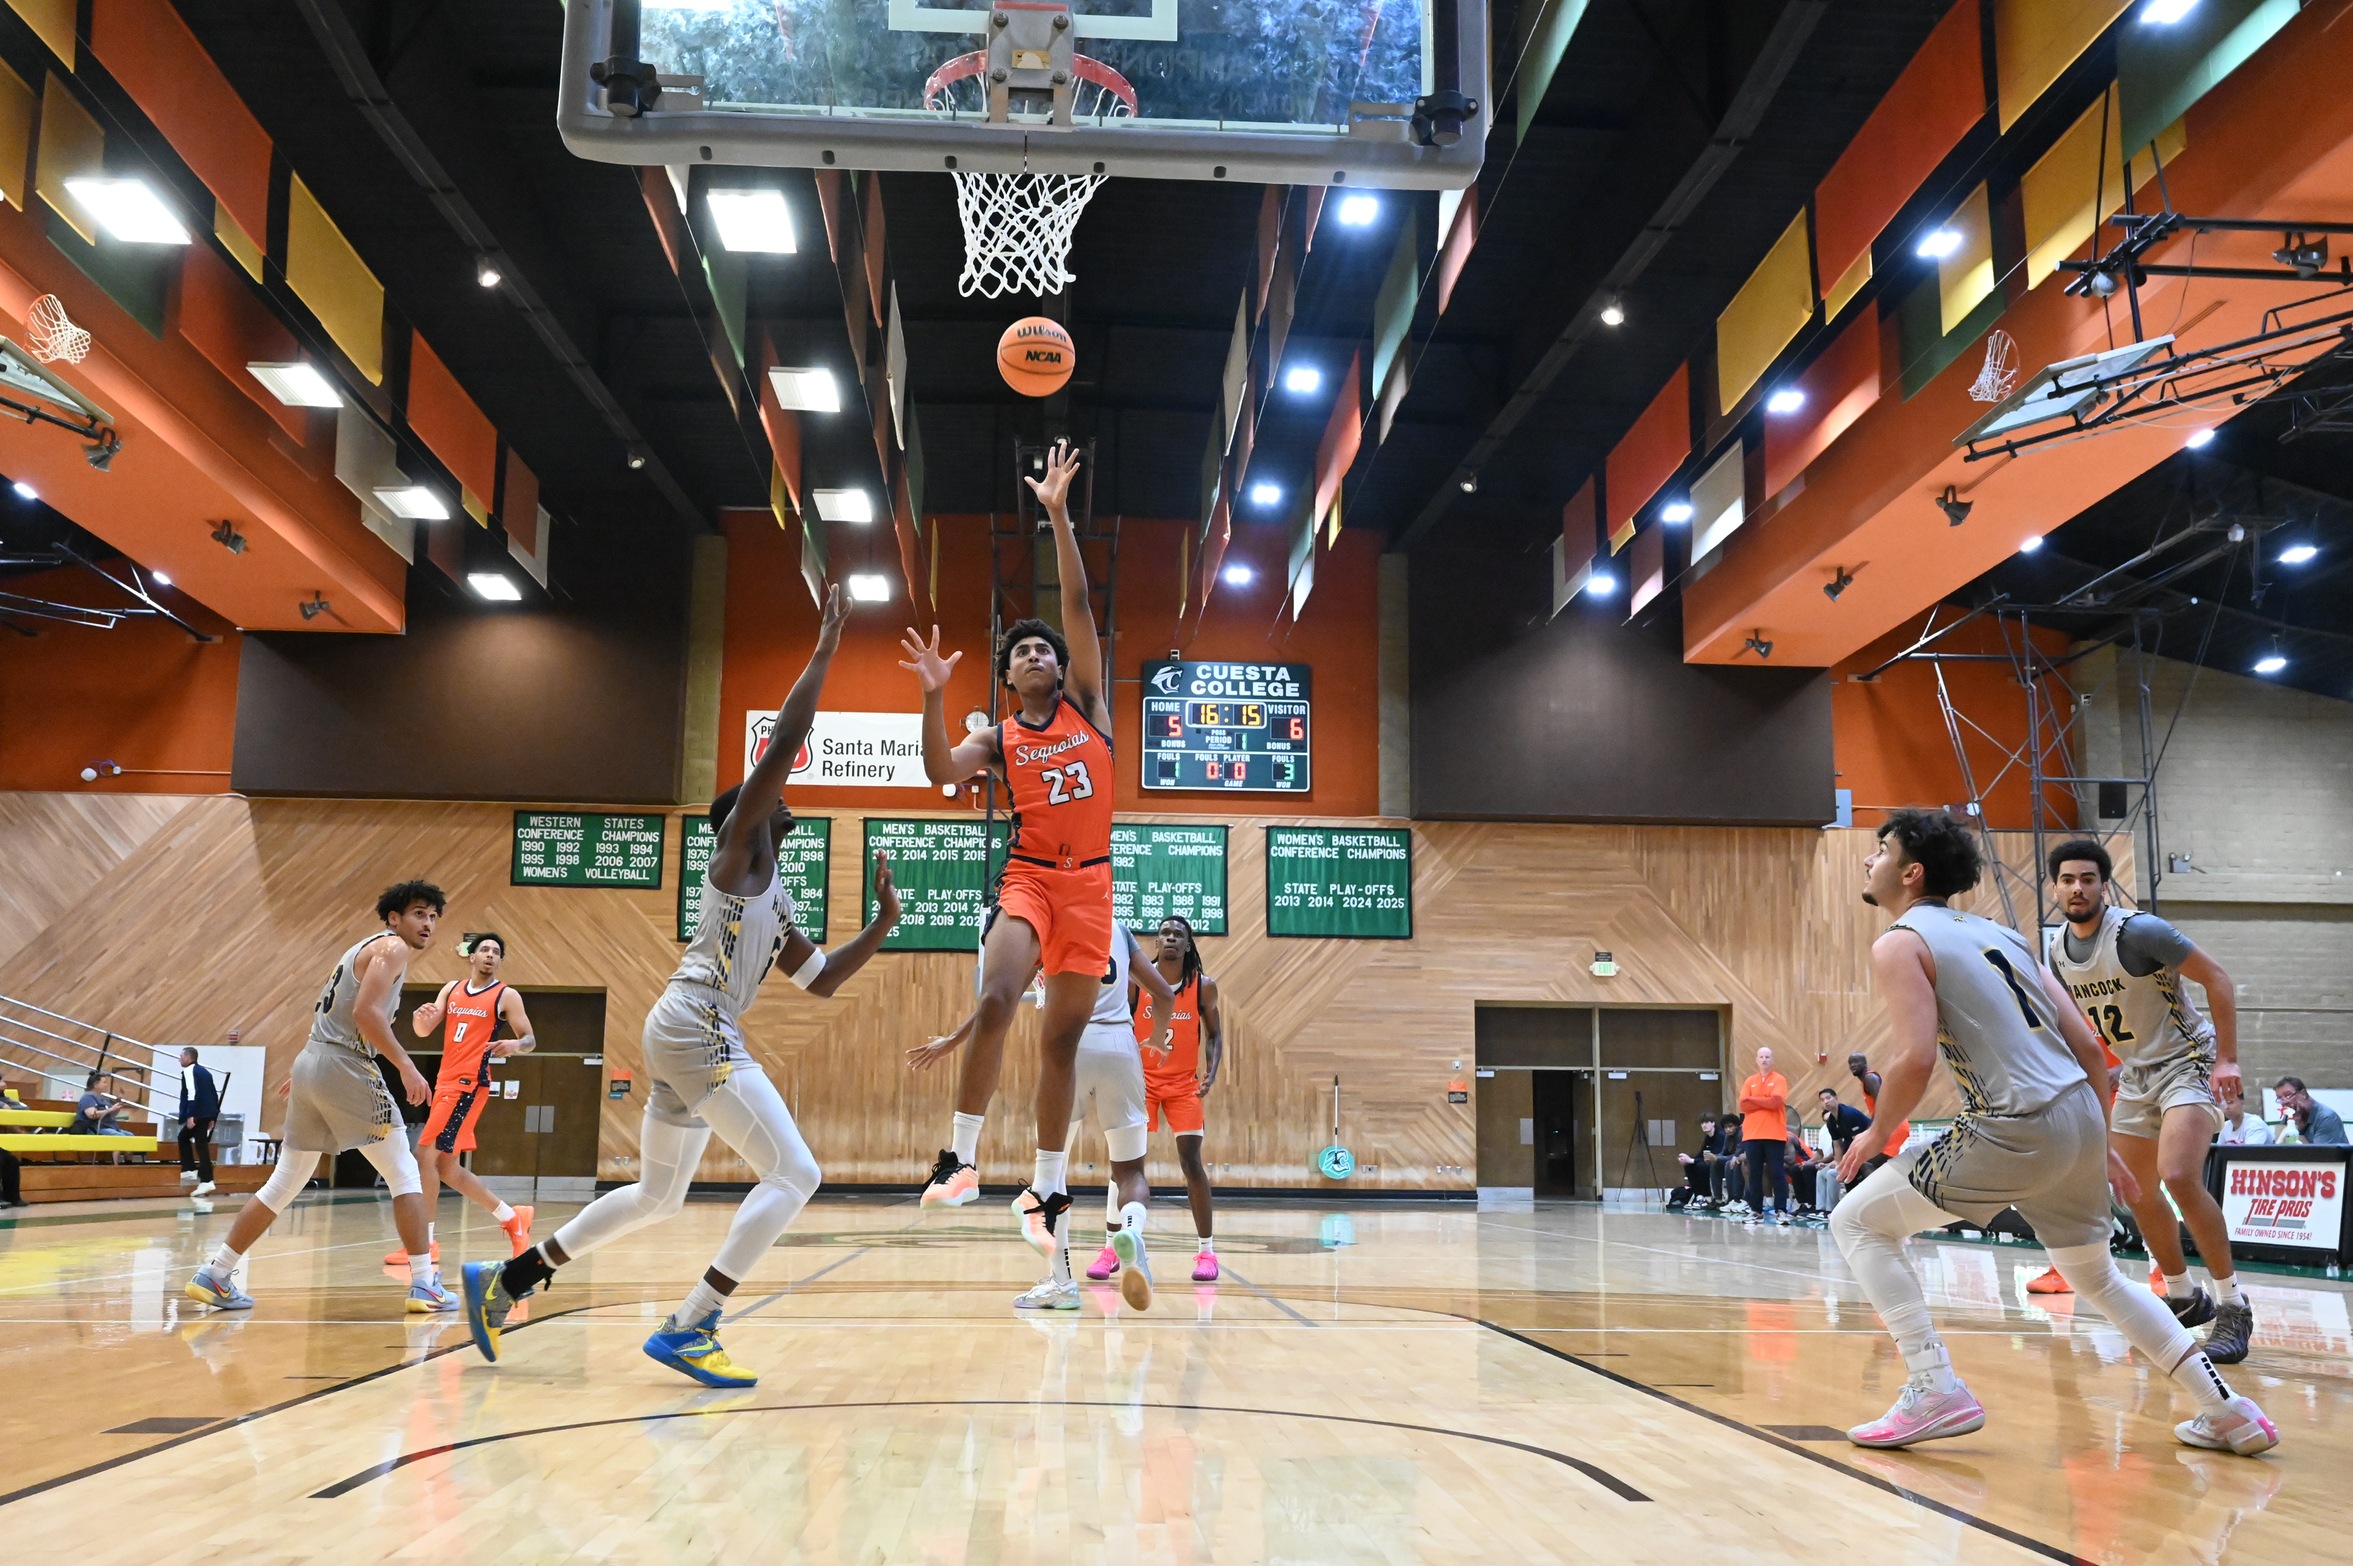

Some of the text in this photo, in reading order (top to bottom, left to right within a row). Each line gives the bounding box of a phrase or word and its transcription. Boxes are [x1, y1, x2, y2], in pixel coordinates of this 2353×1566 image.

[1026, 350, 1061, 364] NCAA
[1196, 664, 1290, 680] CUESTA
[1191, 680, 1299, 696] COLLEGE
[1152, 702, 1180, 712] HOME
[1268, 705, 1306, 714] VISITOR
[1168, 716, 1182, 737] 5
[1290, 718, 1304, 740] 6
[1161, 740, 1186, 748] BONUS
[1206, 736, 1232, 744] PERIOD
[1242, 734, 1247, 750] 1
[1266, 742, 1291, 750] BONUS
[822, 738, 873, 756] Santa
[1016, 730, 1089, 766] Sequoias
[1224, 754, 1250, 762] PLAYER
[1272, 755, 1294, 763] FOULS
[822, 761, 896, 781] Refinery
[1174, 762, 1180, 778] 1
[1284, 764, 1294, 780] 3
[1040, 760, 1094, 806] 23
[530, 816, 644, 829] WESTERN STATES
[883, 824, 915, 834] MEN'S
[518, 828, 659, 842] CONFERENCE CHAMPIONS
[1152, 832, 1216, 843] BASKETBALL
[1277, 834, 1400, 847] WOMEN'S BASKETBALL
[522, 841, 653, 854] 1990 1992 1993 1994
[780, 838, 824, 849] AMPIONS
[869, 836, 935, 848] CONFERENCE
[688, 849, 709, 859] 1976
[800, 851, 824, 861] 1998
[903, 850, 927, 860] 2014
[933, 850, 958, 860] 2015
[1168, 845, 1223, 856] CHAMPIONS
[1270, 846, 1406, 859] CONFERENCE CHAMPIONS
[521, 854, 657, 867] 1995 1998 2006 2007
[1113, 857, 1135, 867] 1982
[523, 867, 649, 880] WOMEN'S VOLLEYBALL
[780, 862, 805, 873] 2010
[801, 888, 823, 899] 1984
[1148, 882, 1202, 893] PLAY-OFFS
[1284, 883, 1394, 896] STATE PLAY-OFFS
[928, 889, 982, 900] PLAY-OFFS
[1112, 894, 1220, 907] 1982 1983 1988 1991
[915, 902, 938, 913] 2013
[943, 902, 968, 913] 2014
[1275, 896, 1405, 908] 2013 2014 2024 2025
[1112, 906, 1223, 918] 1995 1996 1997 1998
[900, 914, 925, 925] 2018
[930, 915, 954, 925] 2019
[1984, 948, 2042, 1029] 1
[447, 1002, 488, 1018] Sequoias
[454, 1022, 468, 1042] 0
[2087, 1005, 2135, 1046] 12
[2230, 1169, 2336, 1198] HINSON'S
[2245, 1199, 2312, 1226] TIRE PROS
[2234, 1228, 2253, 1236] FAMILY
[2255, 1229, 2277, 1238] OWNED
[2277, 1231, 2294, 1239] SINCE
